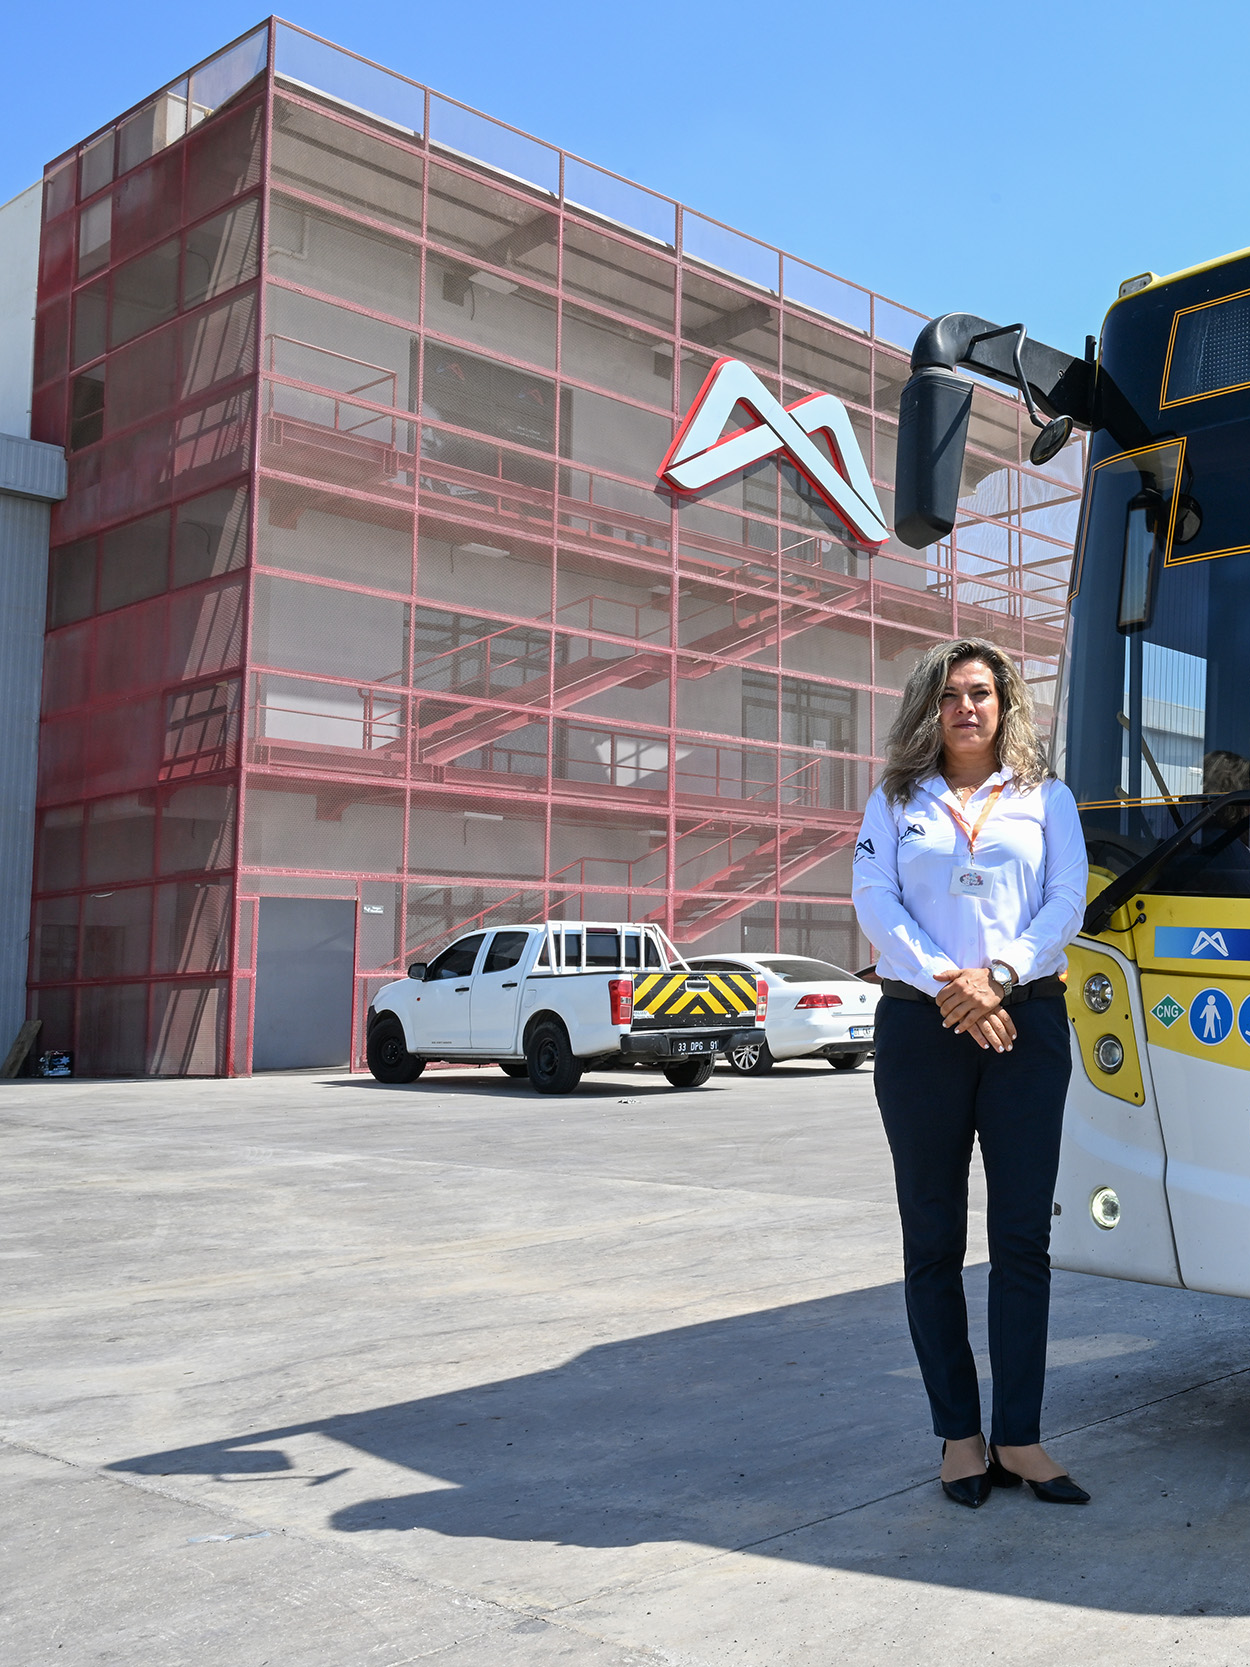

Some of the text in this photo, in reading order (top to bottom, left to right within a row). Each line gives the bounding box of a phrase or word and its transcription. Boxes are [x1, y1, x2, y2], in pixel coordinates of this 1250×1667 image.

[1156, 1004, 1180, 1019] CNG
[677, 1040, 719, 1052] 33 DPG 91
